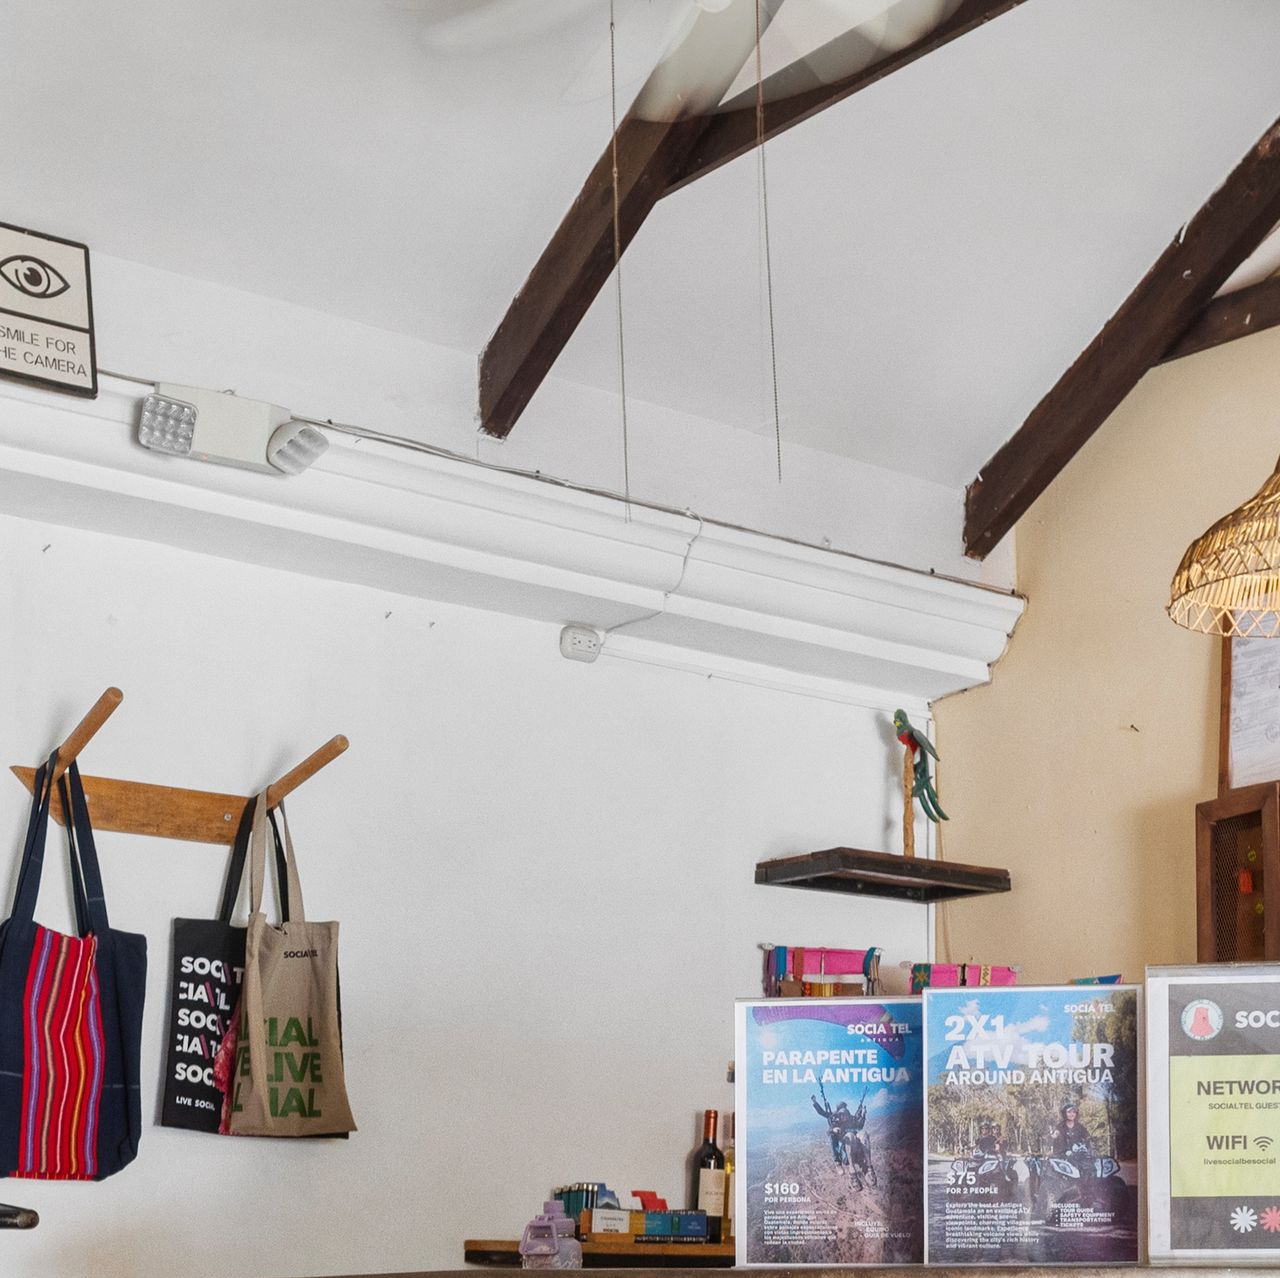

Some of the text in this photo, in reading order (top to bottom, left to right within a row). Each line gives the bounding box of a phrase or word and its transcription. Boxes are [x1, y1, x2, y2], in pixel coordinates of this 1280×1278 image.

[46, 336, 76, 356] FOR
[23, 352, 88, 378] CAMERA
[945, 1014, 1005, 1041] 2X1
[763, 1050, 878, 1065] PARAPENTE
[945, 1043, 1115, 1070] ATV TOUR
[763, 1067, 910, 1084] EN LA ANTIGUA
[945, 1069, 1114, 1085] AROUND ANTIGUA
[176, 1096, 192, 1106] LIVE
[1208, 1102, 1254, 1110] SOCIALTEL
[1206, 1135, 1248, 1150] WIFI
[1204, 1157, 1276, 1165] livesocialbesocial
[946, 1171, 976, 1185] $75
[764, 1183, 799, 1195] $160
